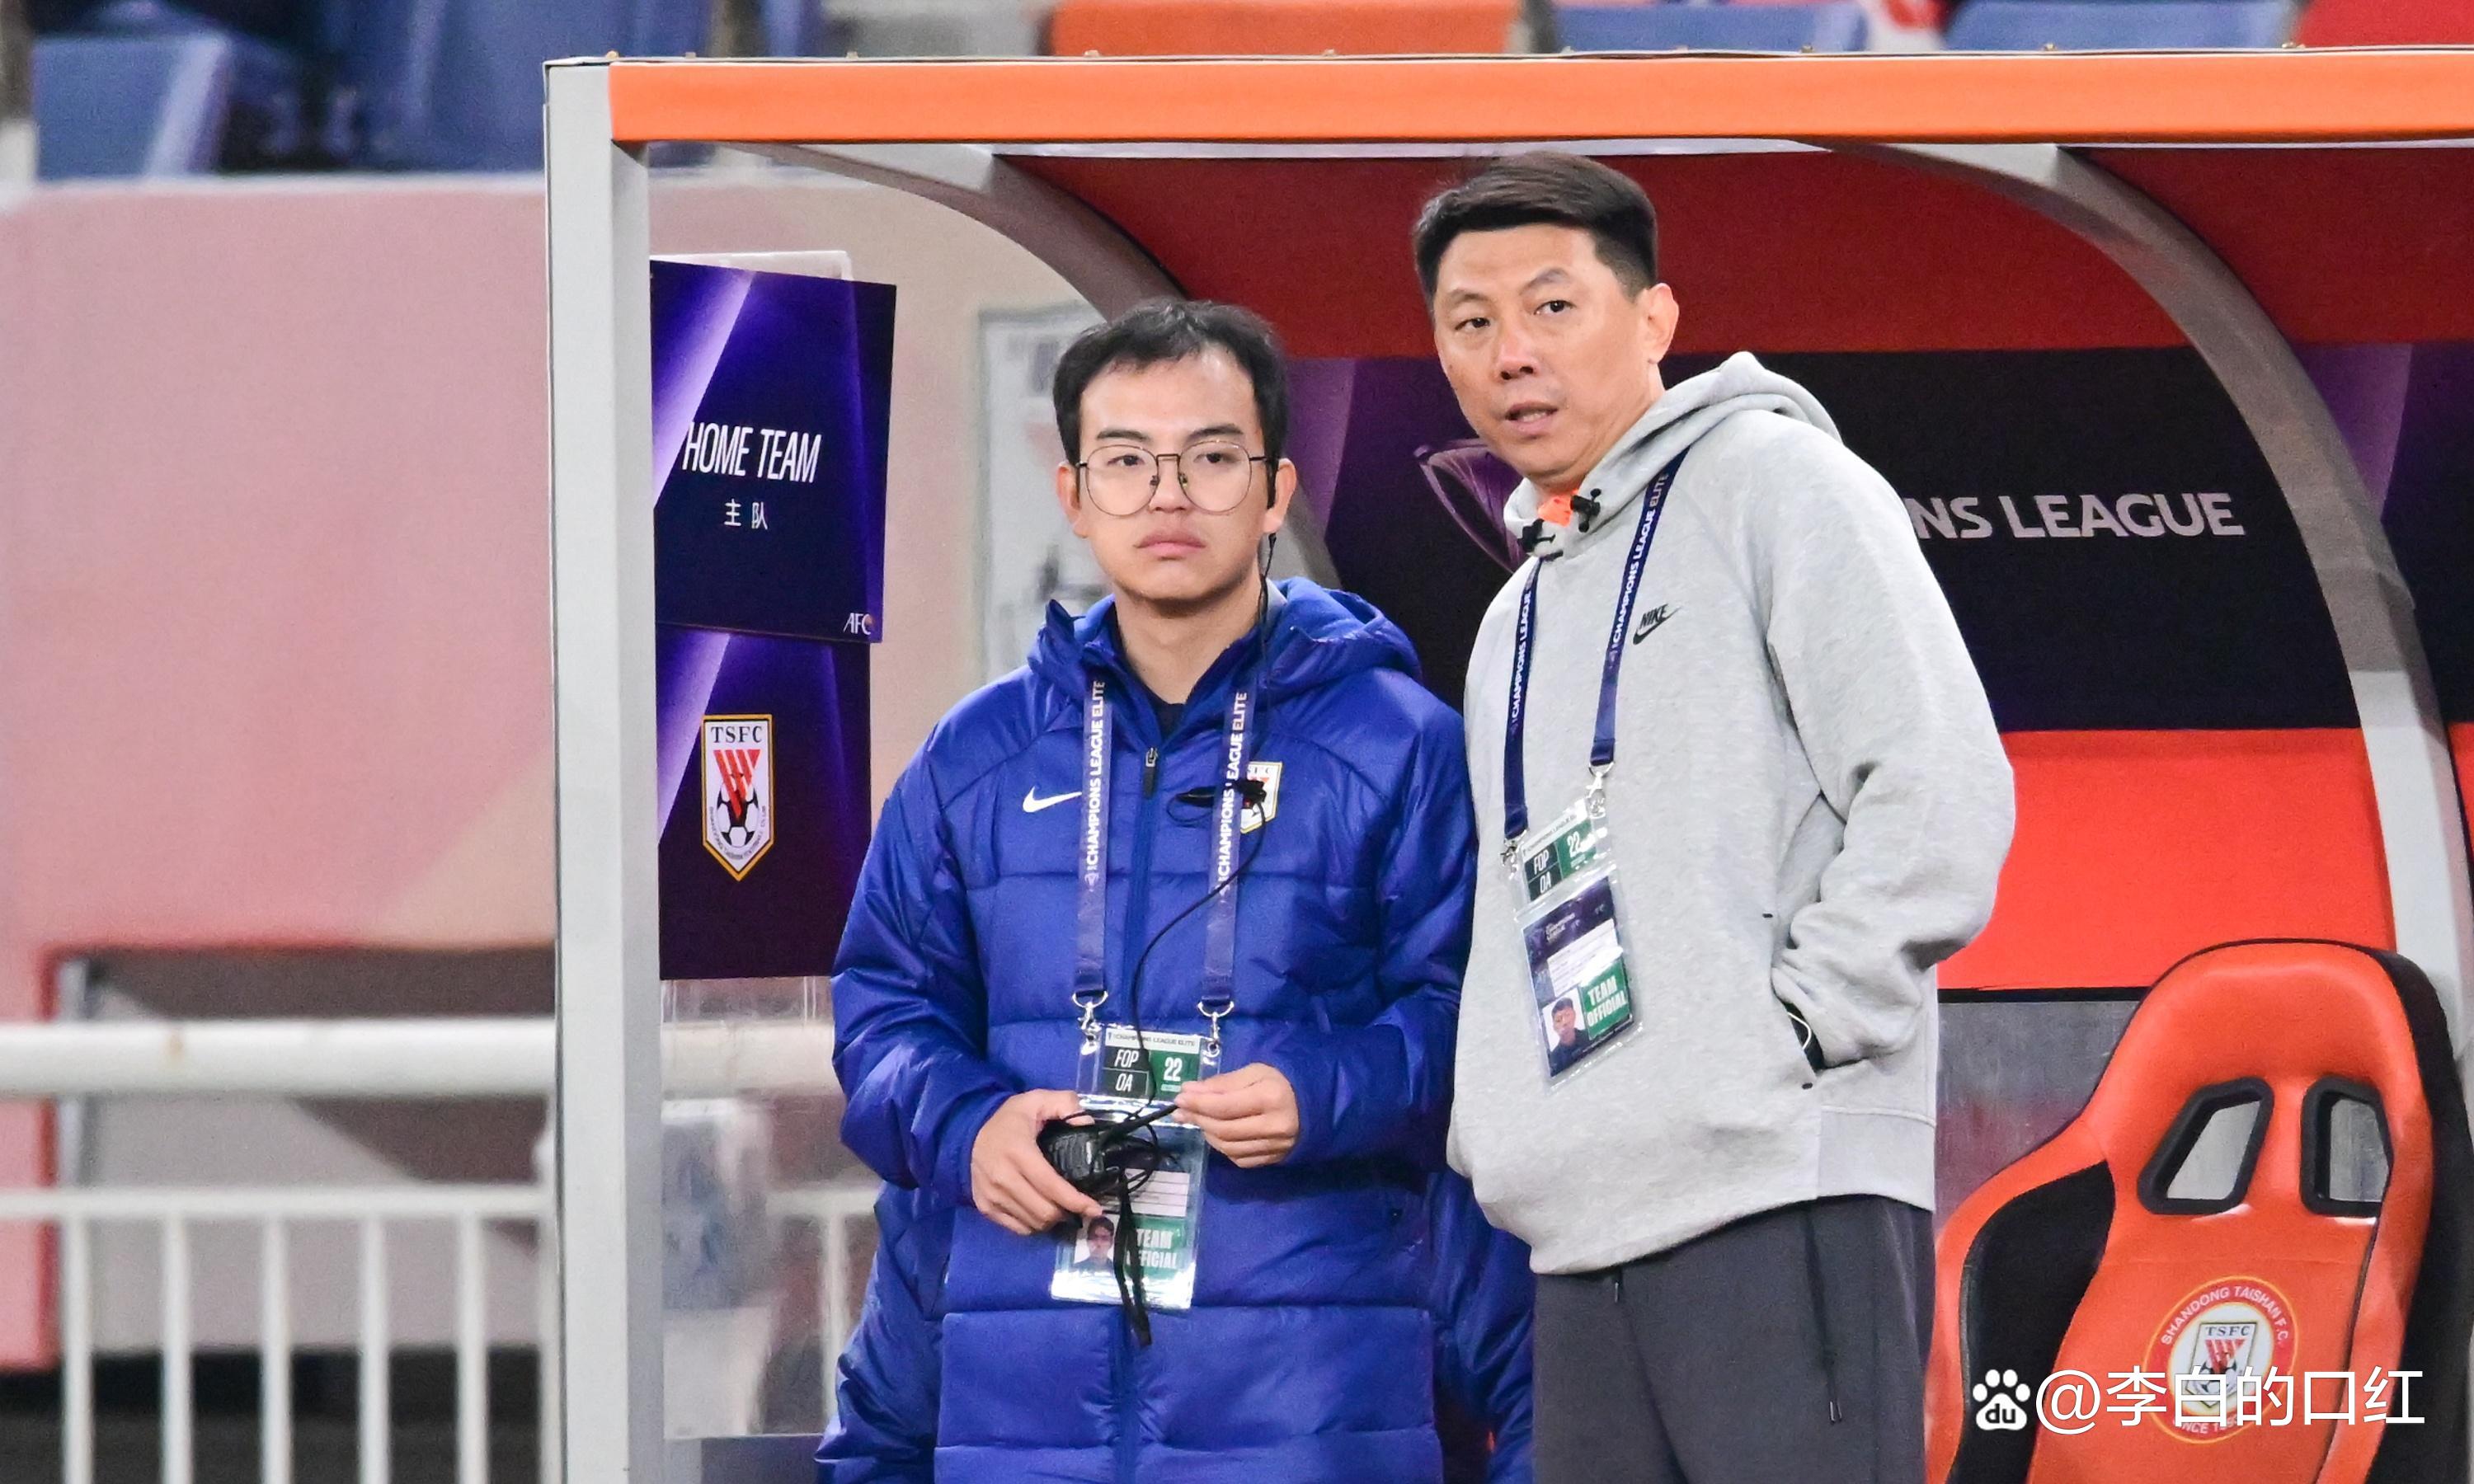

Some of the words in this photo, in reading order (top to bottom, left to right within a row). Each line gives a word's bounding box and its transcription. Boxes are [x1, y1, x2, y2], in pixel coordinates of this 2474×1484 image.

[681, 421, 753, 477] HOME
[756, 428, 821, 483] TEAM
[724, 499, 768, 530] 主队
[1633, 509, 1656, 560] LEAGUE
[1649, 473, 1669, 508] ELITE
[1999, 492, 2246, 539] LEAGUE
[843, 612, 873, 636] AFC
[1639, 603, 1668, 630] NIKE
[1092, 681, 1105, 717] ELITE
[710, 726, 763, 743] TSFC
[1089, 719, 1103, 777] LEAGUE
[1218, 788, 1235, 876] CHAMPIONS
[1233, 693, 1248, 731] ELITE
[1086, 777, 1101, 866] CHAMPIONS
[1534, 849, 1550, 875] FOP
[1540, 871, 1551, 894] OA
[1587, 975, 1617, 1006] TEAM
[1587, 990, 1627, 1026] OFFICIAL
[1113, 1049, 1139, 1068] FOP
[1163, 1056, 1183, 1082] 22
[1115, 1073, 1133, 1092] OA
[1136, 1228, 1174, 1249] TEAM
[1126, 1250, 1178, 1269] FICIAL
[2161, 1287, 2231, 1345] SHANDONG
[2234, 1285, 2283, 1318] TAISHAN
[2205, 1325, 2251, 1336] TSFC
